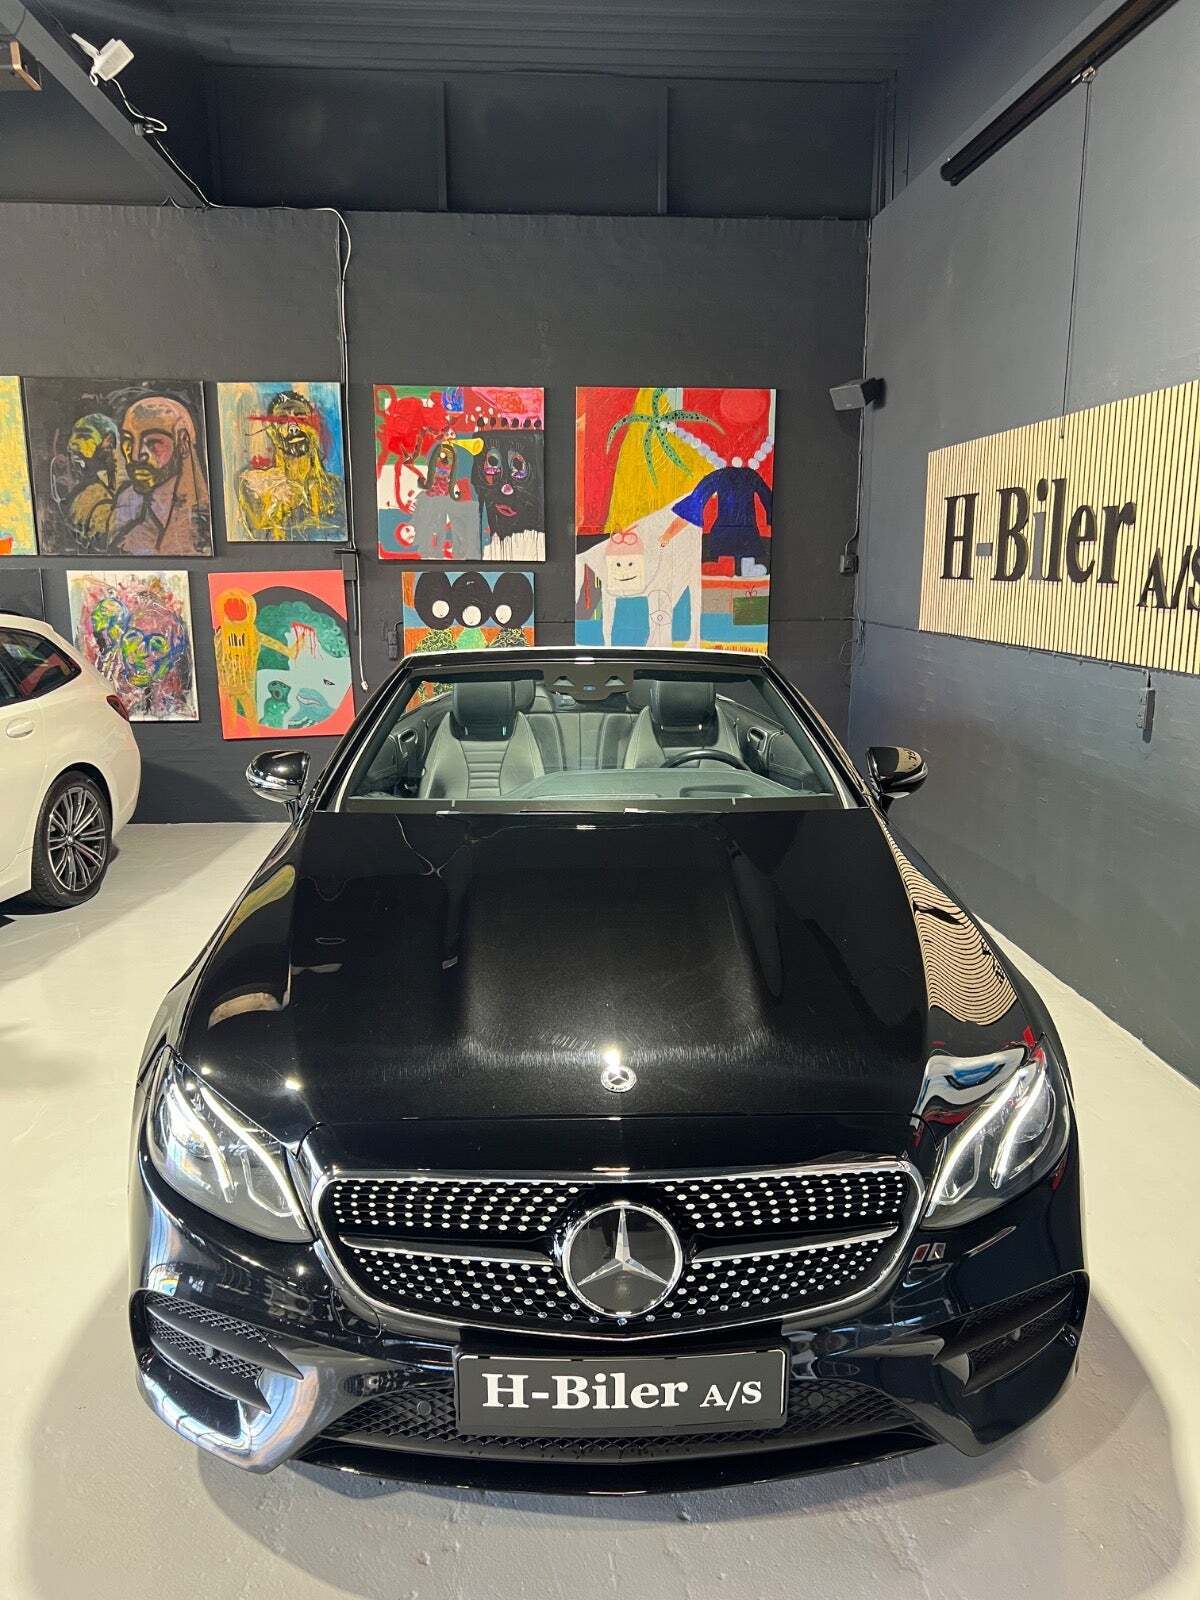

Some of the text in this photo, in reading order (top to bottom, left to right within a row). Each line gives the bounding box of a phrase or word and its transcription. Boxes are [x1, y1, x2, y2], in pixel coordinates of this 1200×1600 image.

[940, 478, 1136, 584] H-Biler
[482, 1372, 762, 1411] H-Biler A/S
